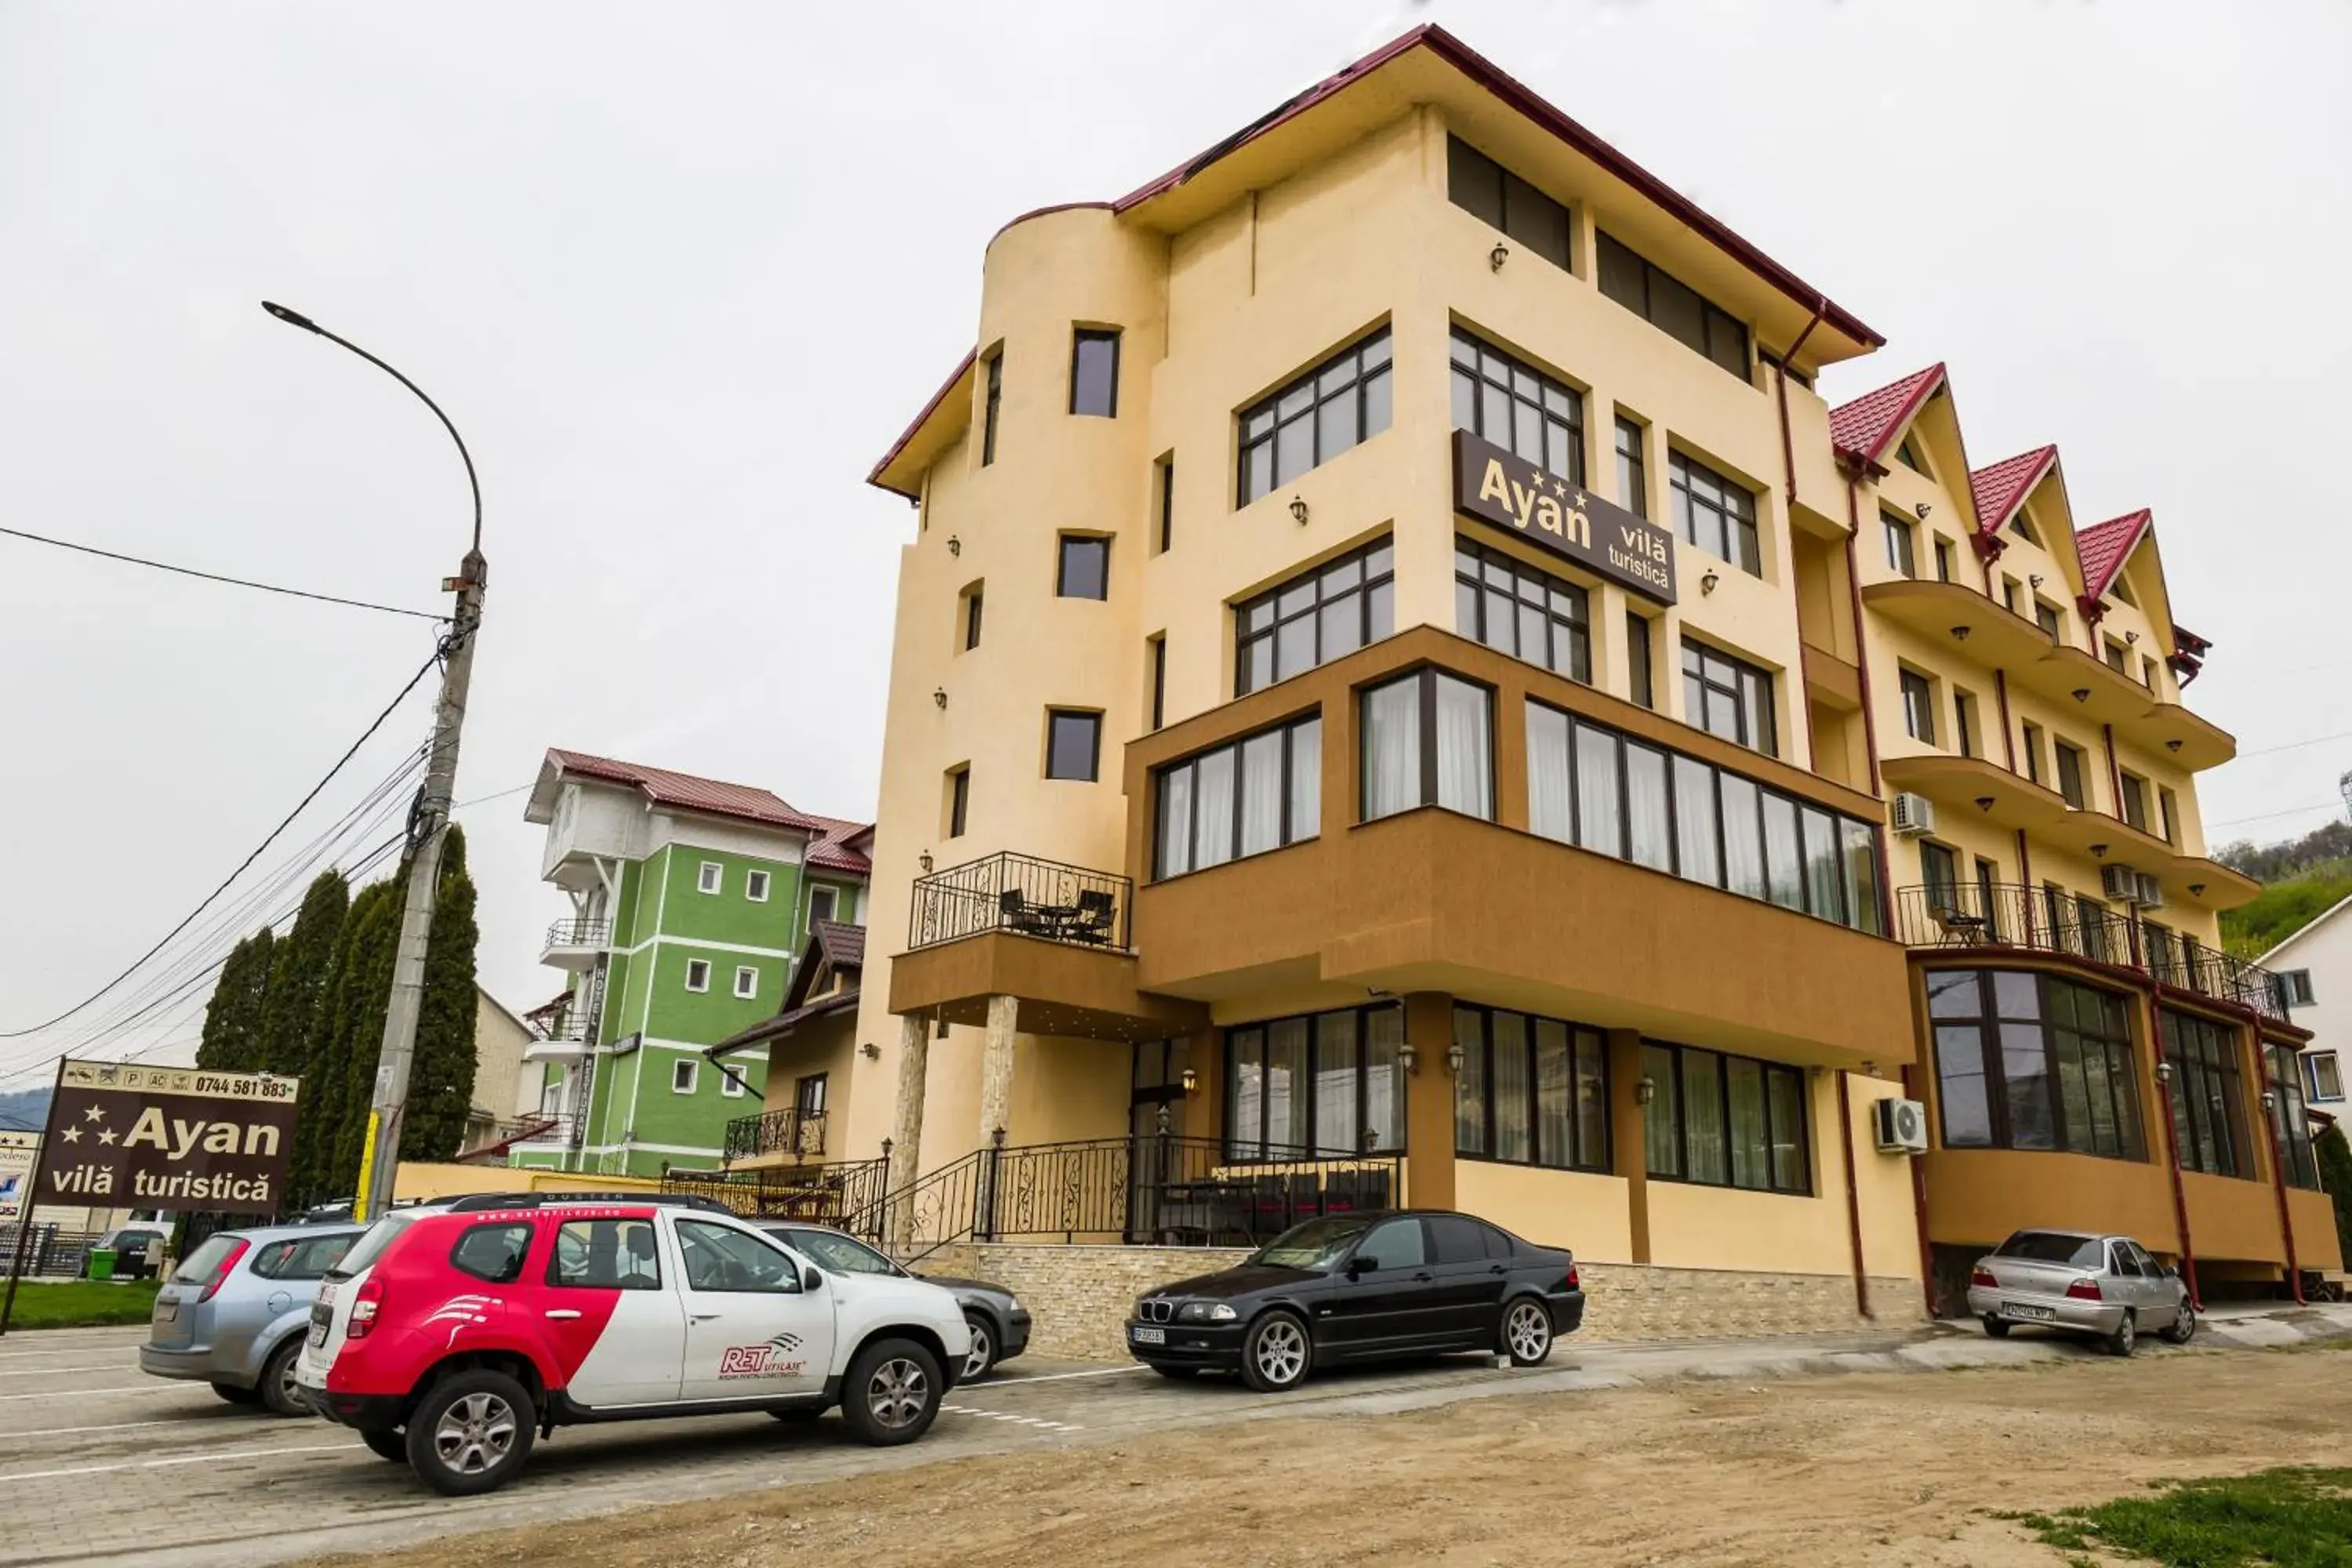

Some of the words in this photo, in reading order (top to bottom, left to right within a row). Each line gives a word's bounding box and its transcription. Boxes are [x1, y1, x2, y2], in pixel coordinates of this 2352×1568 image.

[1479, 458, 1591, 549] Ayan
[1621, 526, 1667, 564] vilă
[1608, 544, 1668, 589] turistică
[195, 1076, 230, 1093] 0744
[233, 1080, 257, 1095] 581
[122, 1107, 280, 1160] Ayan
[53, 1164, 113, 1194] vilă
[134, 1170, 270, 1201] turistică
[720, 1346, 771, 1373] RET
